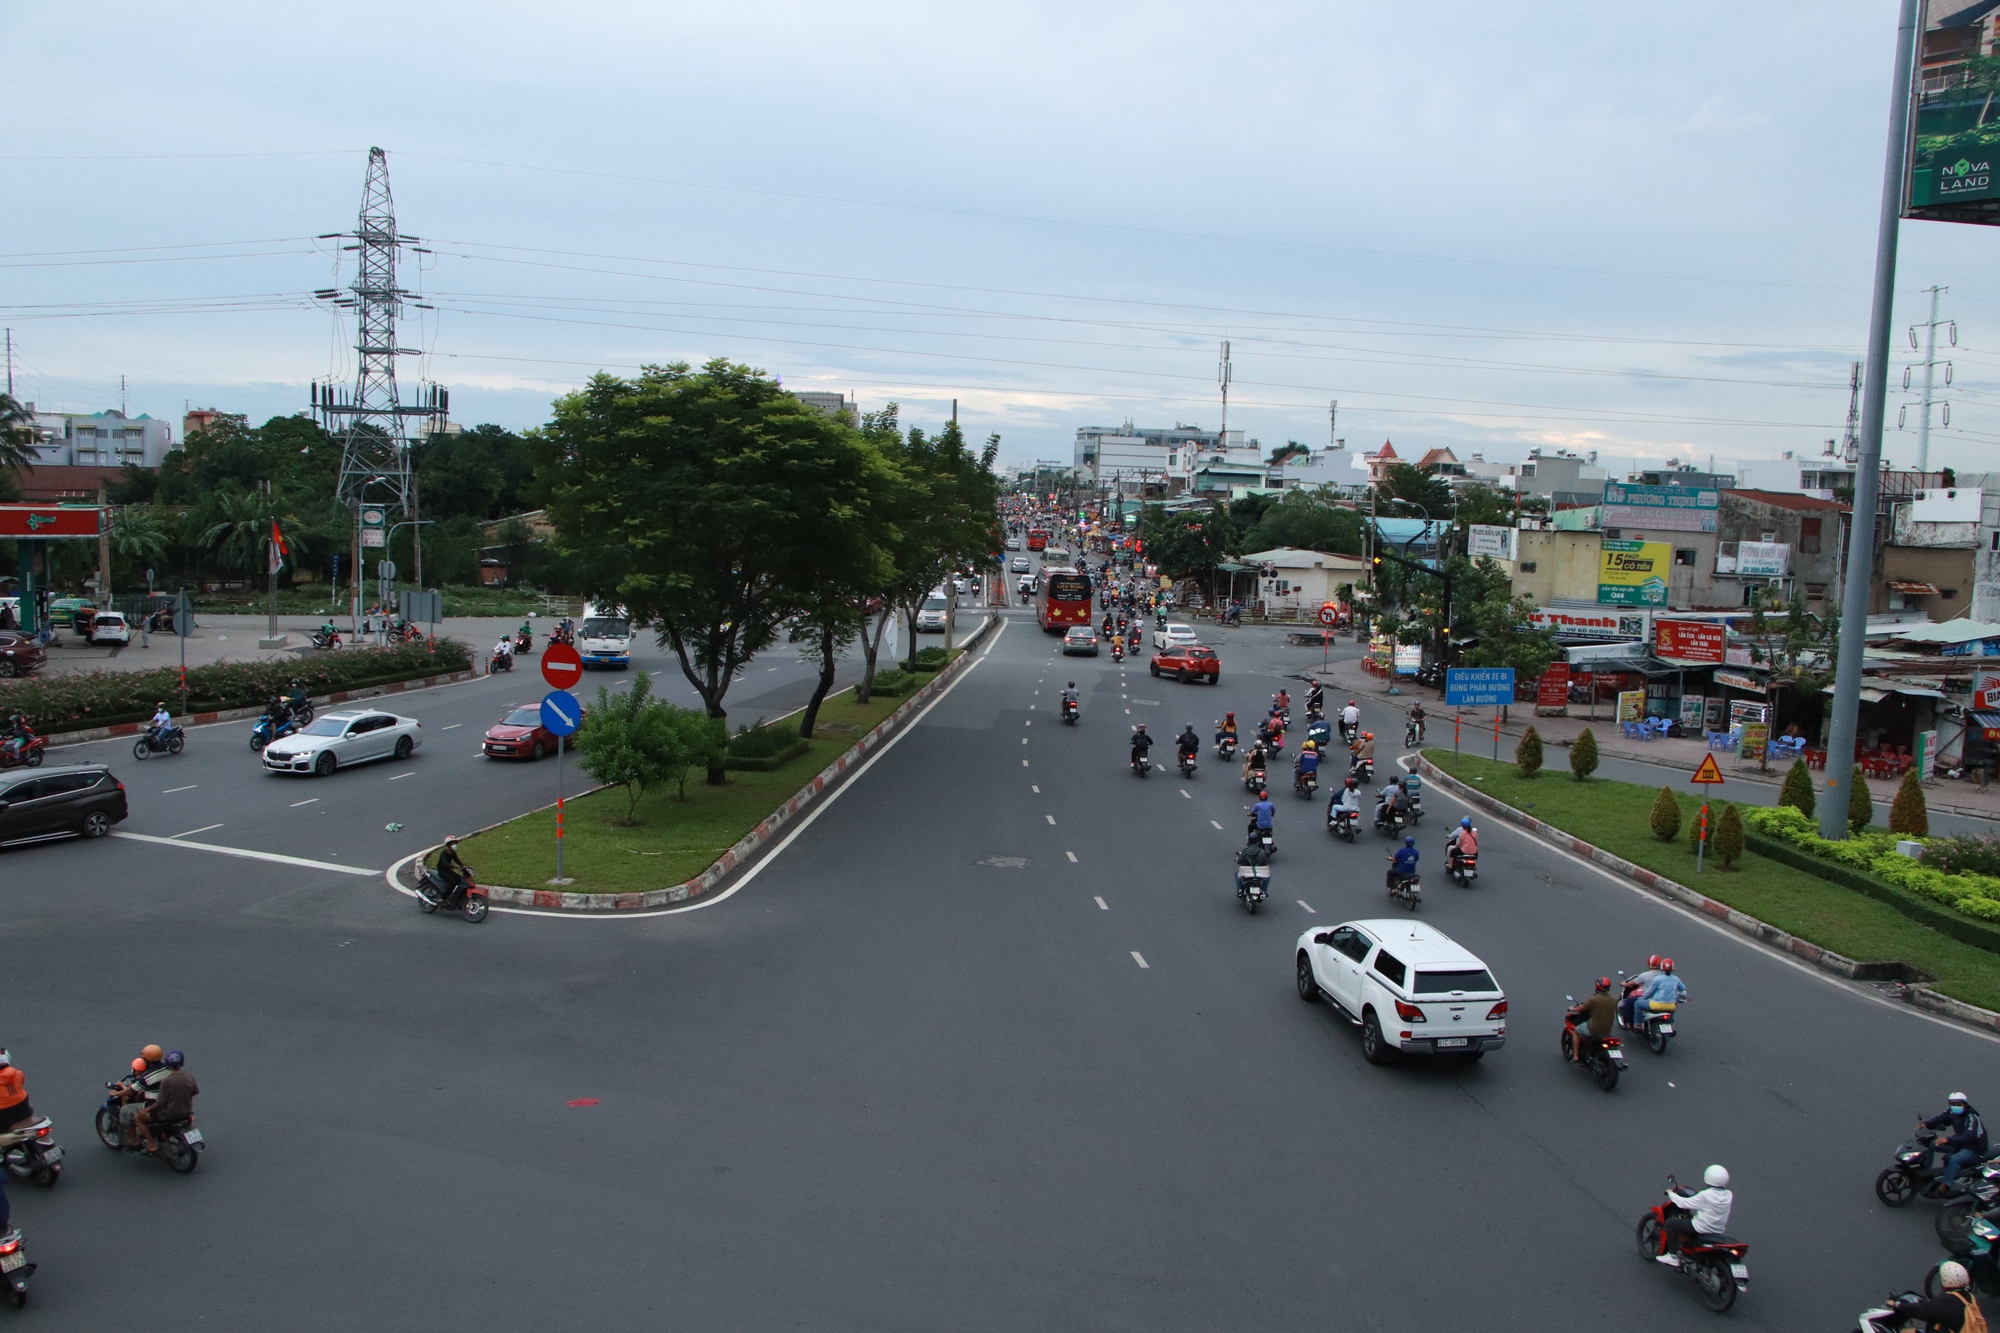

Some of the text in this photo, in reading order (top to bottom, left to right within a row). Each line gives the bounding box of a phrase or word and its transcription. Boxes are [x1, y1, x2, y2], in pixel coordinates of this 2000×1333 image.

[1940, 176, 1989, 190] LAND
[1607, 553, 1624, 566] 15
[1548, 614, 1616, 628] Thanh
[1455, 671, 1469, 680] ĐIỀU
[1471, 670, 1490, 680] KHIỂN
[1450, 682, 1510, 691] ĐÚNG PHẦN ĐƯỜNG
[1463, 693, 1497, 703] LÀN ĐƯỜNG
